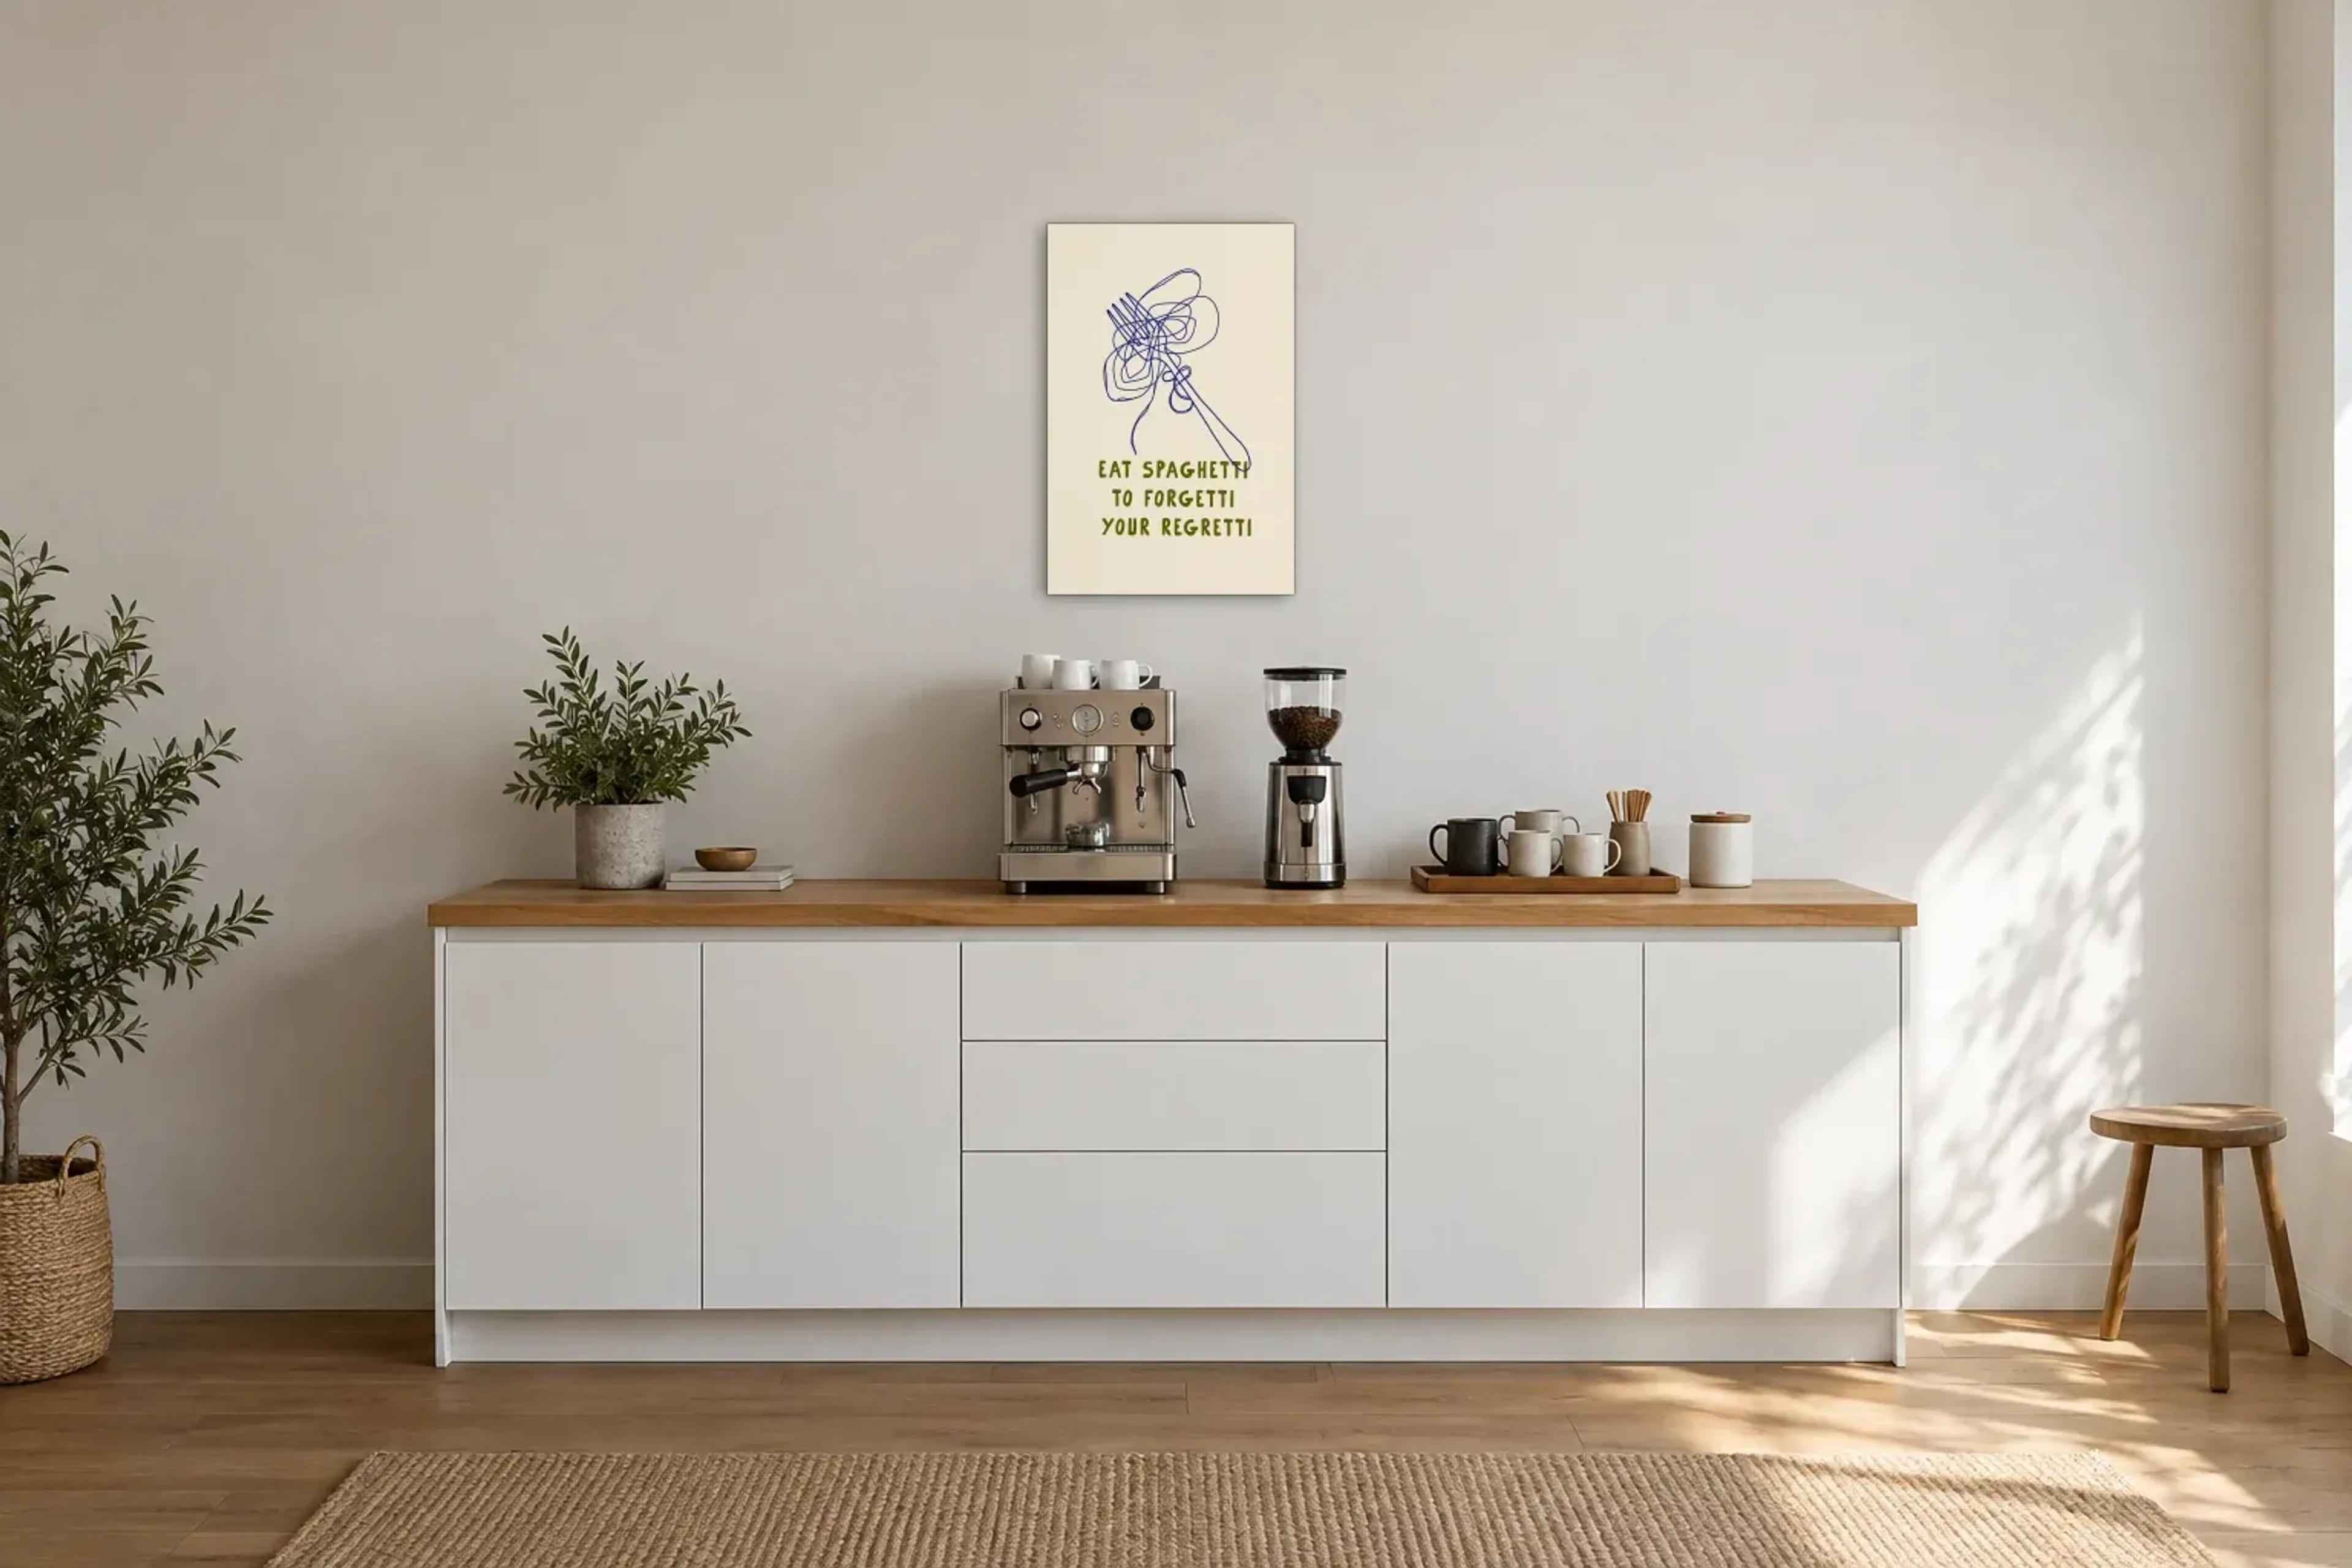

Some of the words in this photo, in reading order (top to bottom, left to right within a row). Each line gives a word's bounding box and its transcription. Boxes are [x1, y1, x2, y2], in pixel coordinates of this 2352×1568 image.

[1098, 460, 1131, 478] EAT
[1143, 460, 1248, 478] SPAGHETTI
[1112, 489, 1133, 507] TO
[1144, 489, 1234, 508] FORGETTI
[1102, 518, 1150, 536] YOUR
[1162, 518, 1252, 537] REGRETTI
